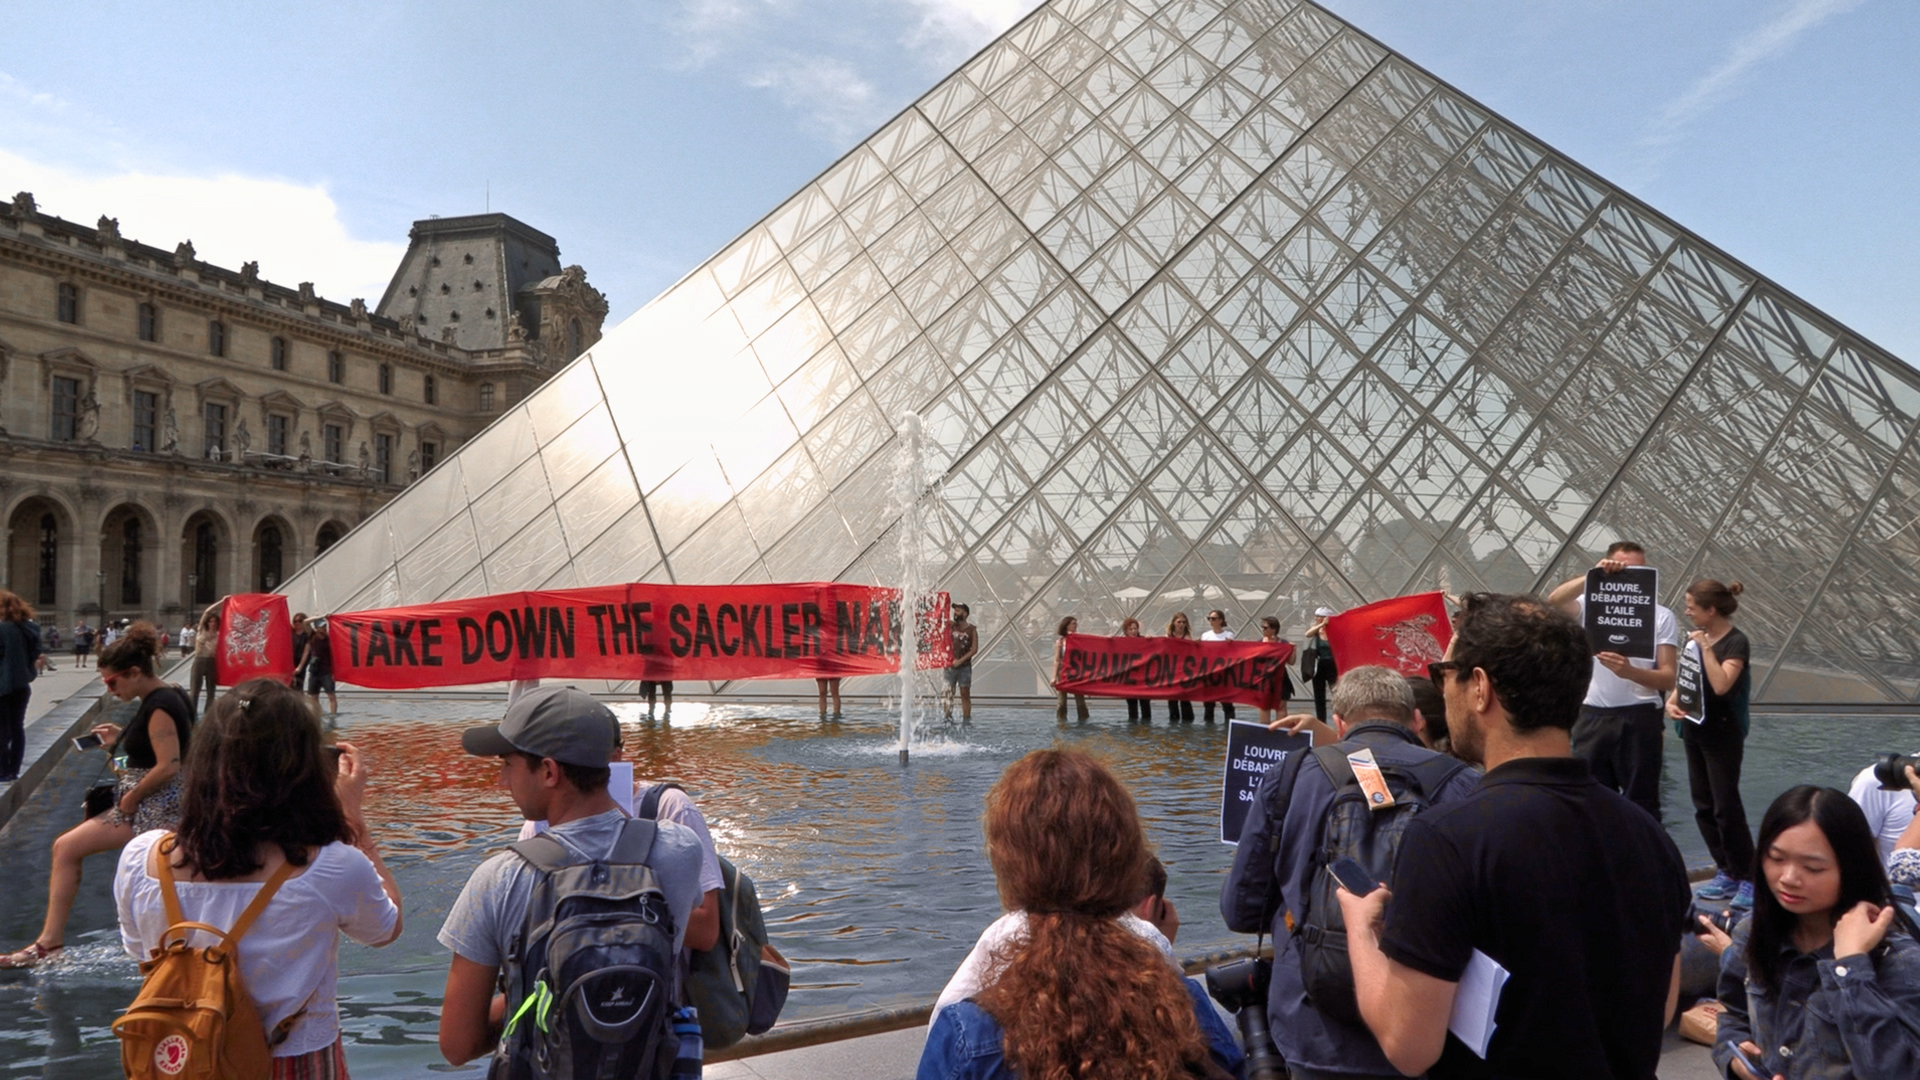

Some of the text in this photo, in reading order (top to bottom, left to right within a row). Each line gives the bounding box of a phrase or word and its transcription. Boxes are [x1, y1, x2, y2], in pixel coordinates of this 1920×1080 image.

[1600, 582, 1642, 594] LOUVRE,
[1591, 592, 1650, 604] DÉBAPTISEZ
[1605, 606, 1635, 615] L'AILE
[1597, 616, 1643, 627] SACKLER
[342, 619, 443, 668] TAKE
[457, 606, 575, 665] DOWN
[586, 602, 652, 657] THE
[669, 602, 822, 658] SACKLER
[1067, 649, 1278, 693] SHAME ON SACKLER
[1233, 757, 1274, 773] DÉBAP
